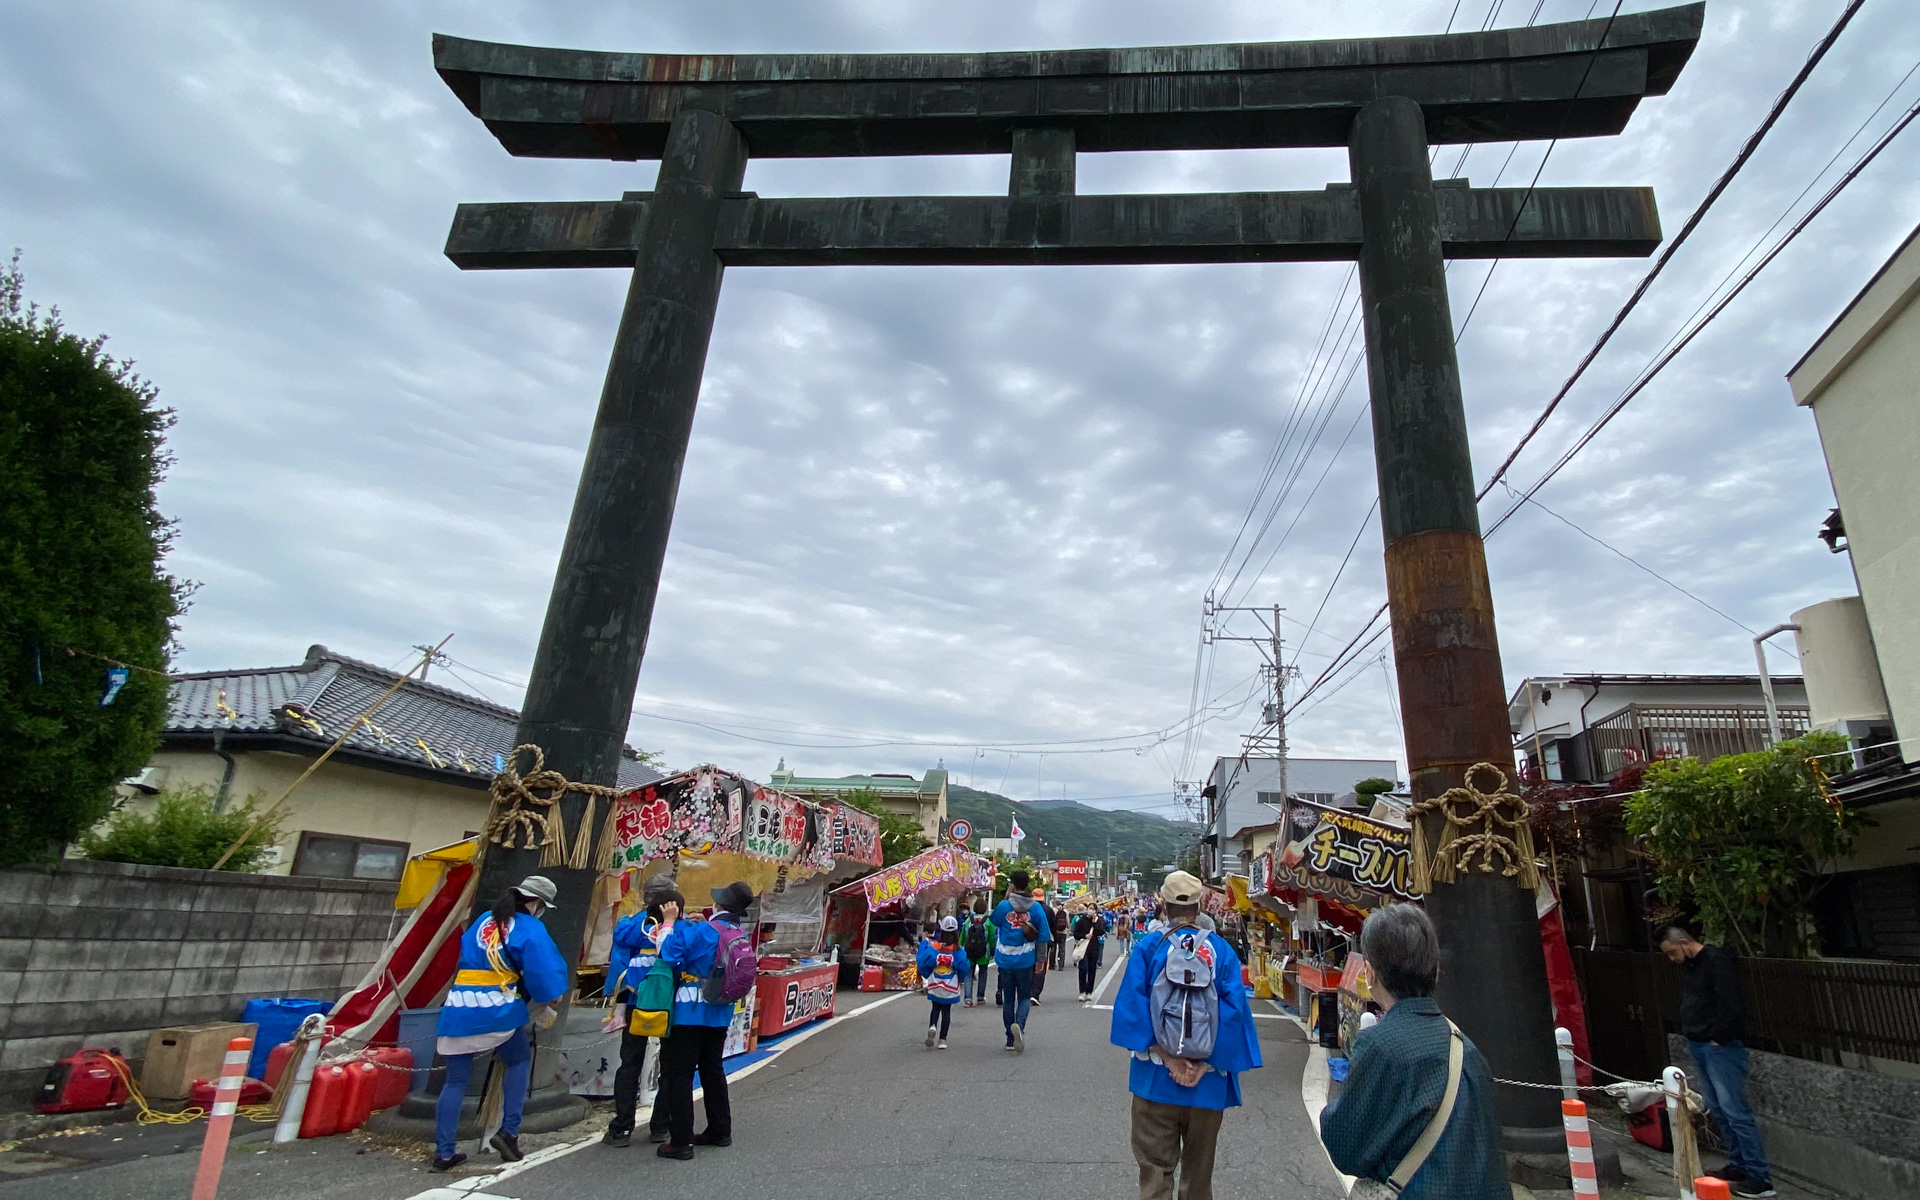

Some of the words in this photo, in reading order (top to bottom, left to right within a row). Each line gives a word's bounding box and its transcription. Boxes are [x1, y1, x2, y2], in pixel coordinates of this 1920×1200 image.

[954, 826, 967, 836] 40
[1312, 829, 1422, 894] チーズハ
[1058, 866, 1085, 875] SEIYU
